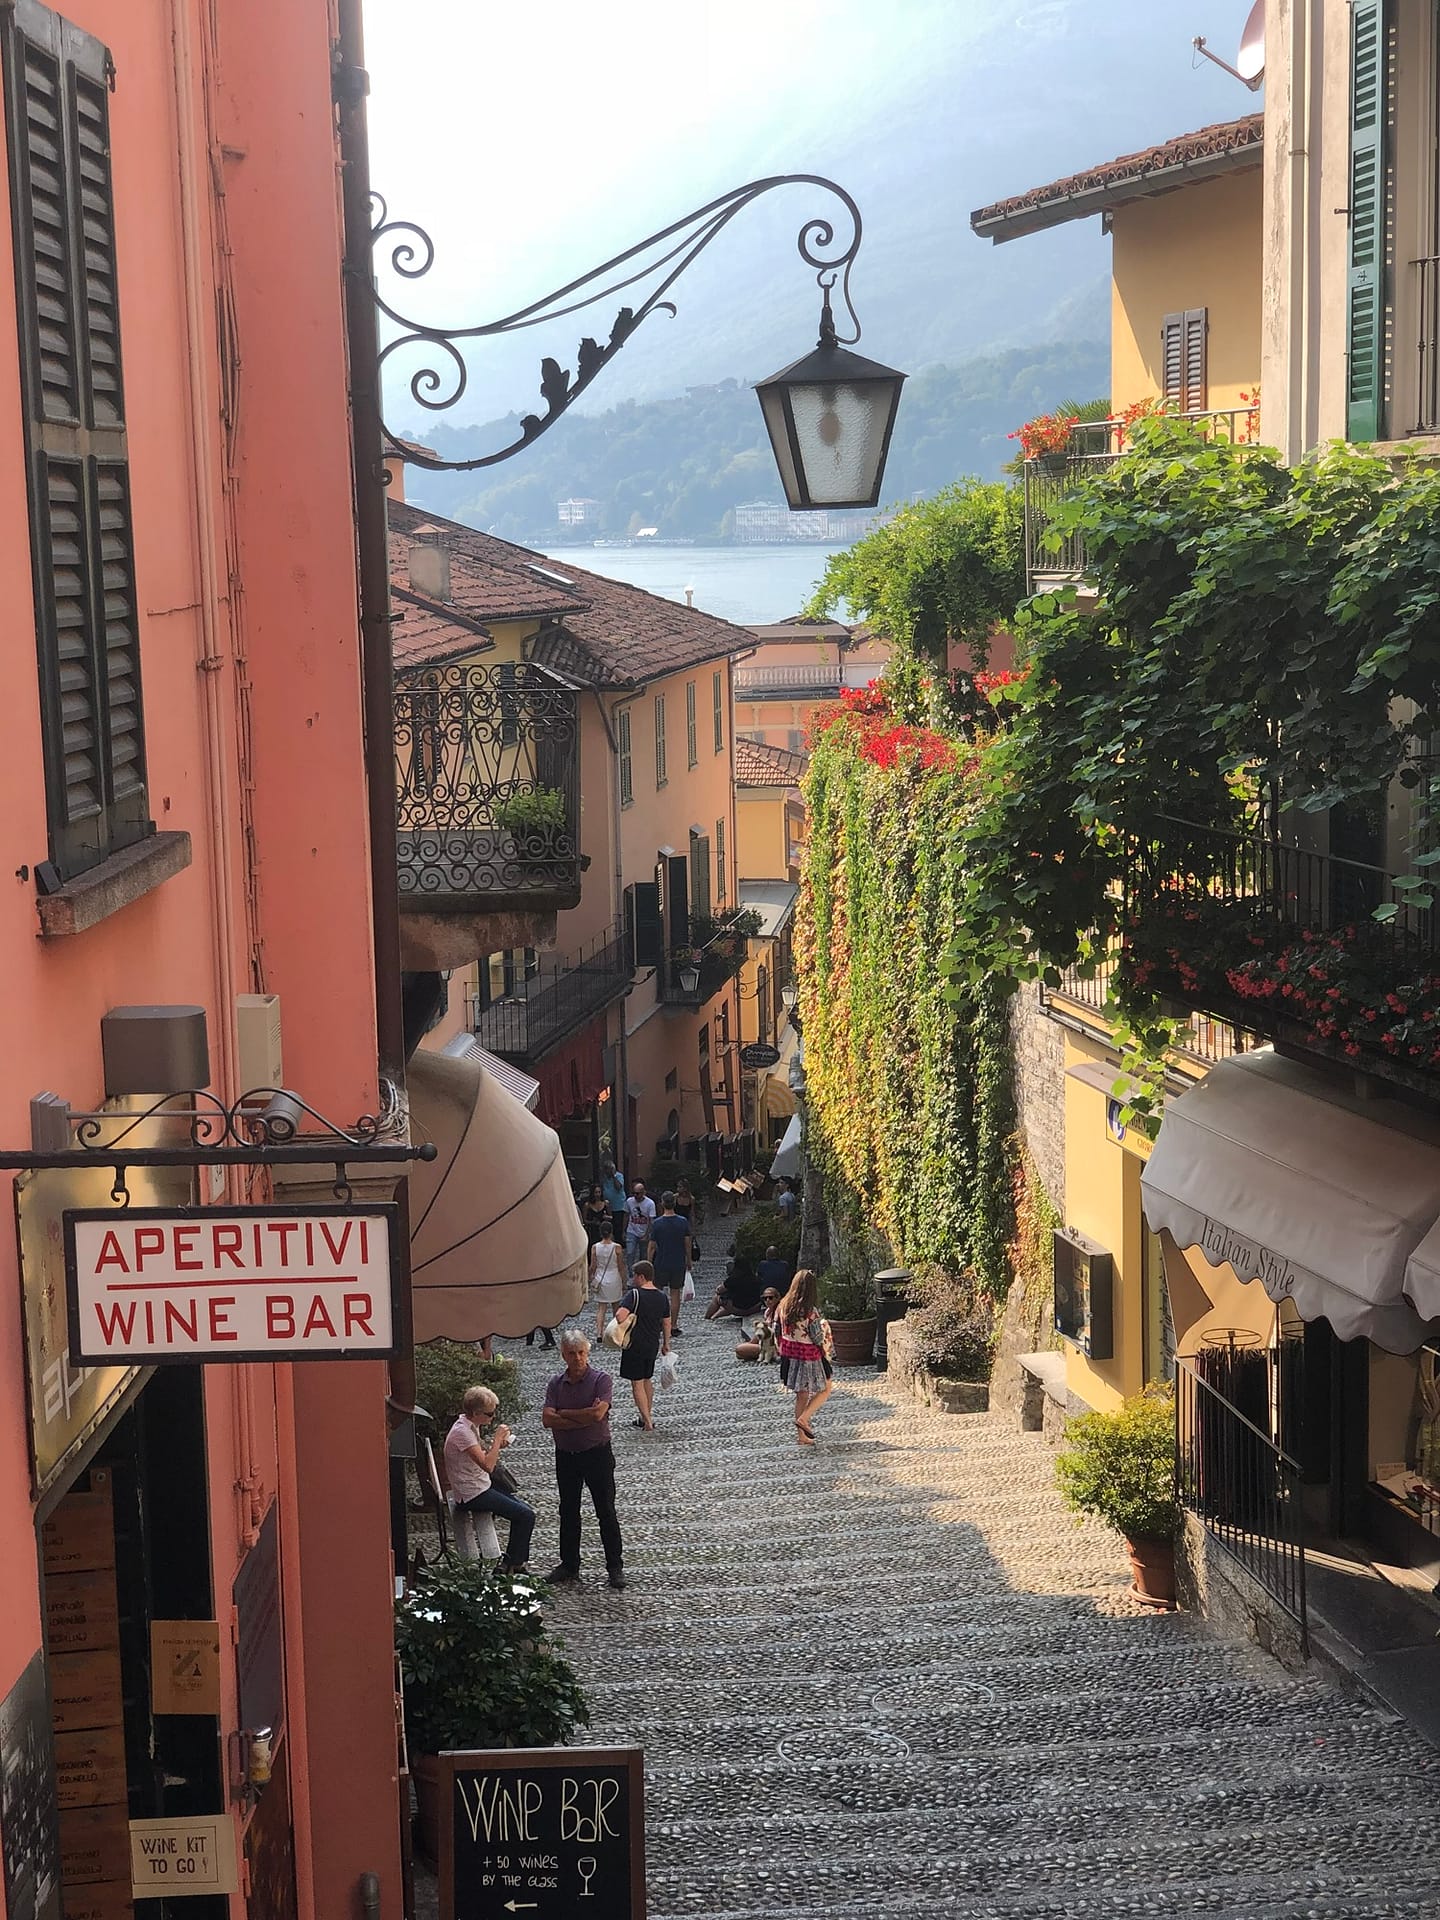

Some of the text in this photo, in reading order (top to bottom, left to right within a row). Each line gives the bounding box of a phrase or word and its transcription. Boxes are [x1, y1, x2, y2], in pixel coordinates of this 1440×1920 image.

[95, 1221, 369, 1273] APERITIVI
[1199, 1218, 1295, 1295] Italian Style
[95, 1293, 376, 1345] WINE BAR
[148, 1858, 196, 1874] TO GO
[496, 1855, 510, 1870] 50
[482, 1875, 496, 1888] BY
